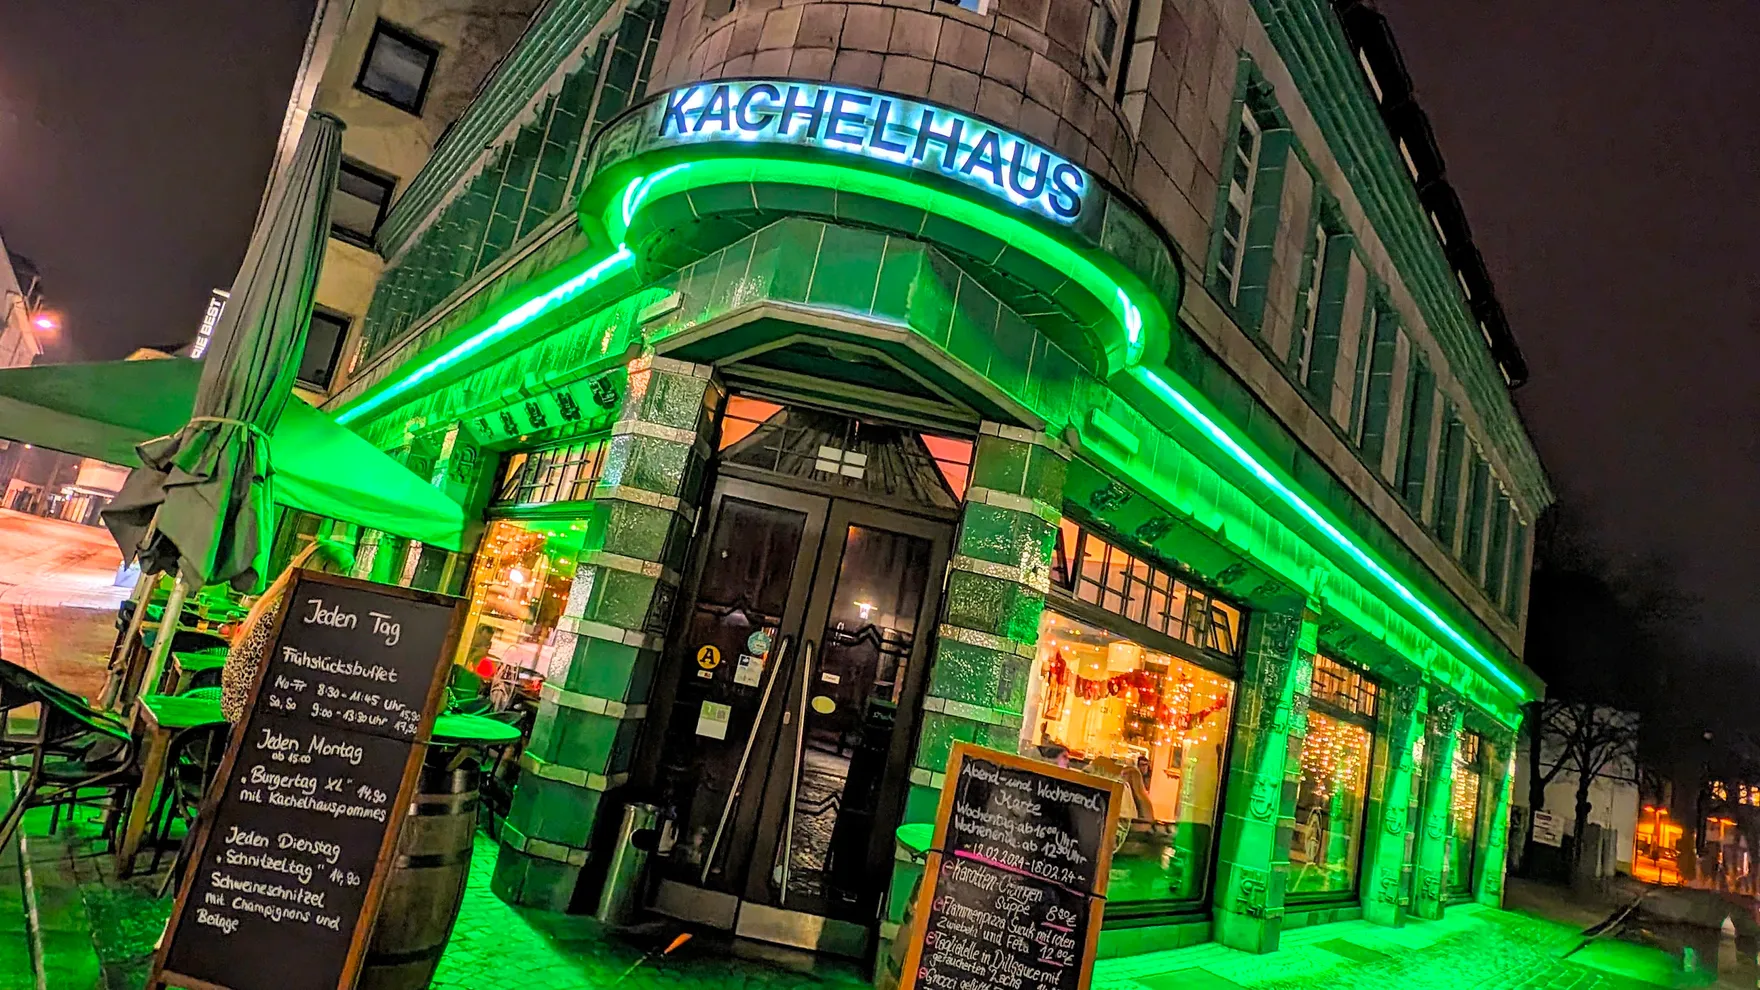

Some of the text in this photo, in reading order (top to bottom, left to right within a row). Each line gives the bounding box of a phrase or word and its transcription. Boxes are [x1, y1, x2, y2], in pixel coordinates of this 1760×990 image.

[659, 84, 1084, 218] KACHELHAUS
[200, 297, 221, 336] BEST
[304, 599, 400, 646] Jeden Tag
[282, 646, 397, 683] Frühstücksbuffet
[701, 647, 716, 665] A
[310, 702, 333, 718] 9:00
[368, 714, 388, 726] Uhr
[317, 684, 340, 699] 8:30
[349, 691, 380, 706] 11:45
[384, 699, 406, 712] Uhr
[257, 728, 363, 765] Jeden Montag
[271, 751, 285, 762] ab
[240, 789, 387, 823] mit Kachelhauspommes
[357, 785, 387, 804] 14,90
[994, 790, 1042, 816] Karte
[225, 826, 341, 865] Jeden Dienstag
[1018, 822, 1033, 834] ab
[1055, 831, 1079, 847] Uhr
[1022, 840, 1038, 852] ab
[211, 871, 325, 909] Schweineschnitzel
[995, 896, 1030, 917] Suppe
[196, 907, 239, 934] Beilage
[205, 892, 340, 931] mit Champignons und
[941, 896, 1006, 929] Flammenpizza
[936, 916, 978, 938] Zwiebeln
[983, 930, 1003, 946] und
[1006, 935, 1029, 953] Feta
[981, 950, 991, 965] in
[1040, 970, 1062, 985] mit
